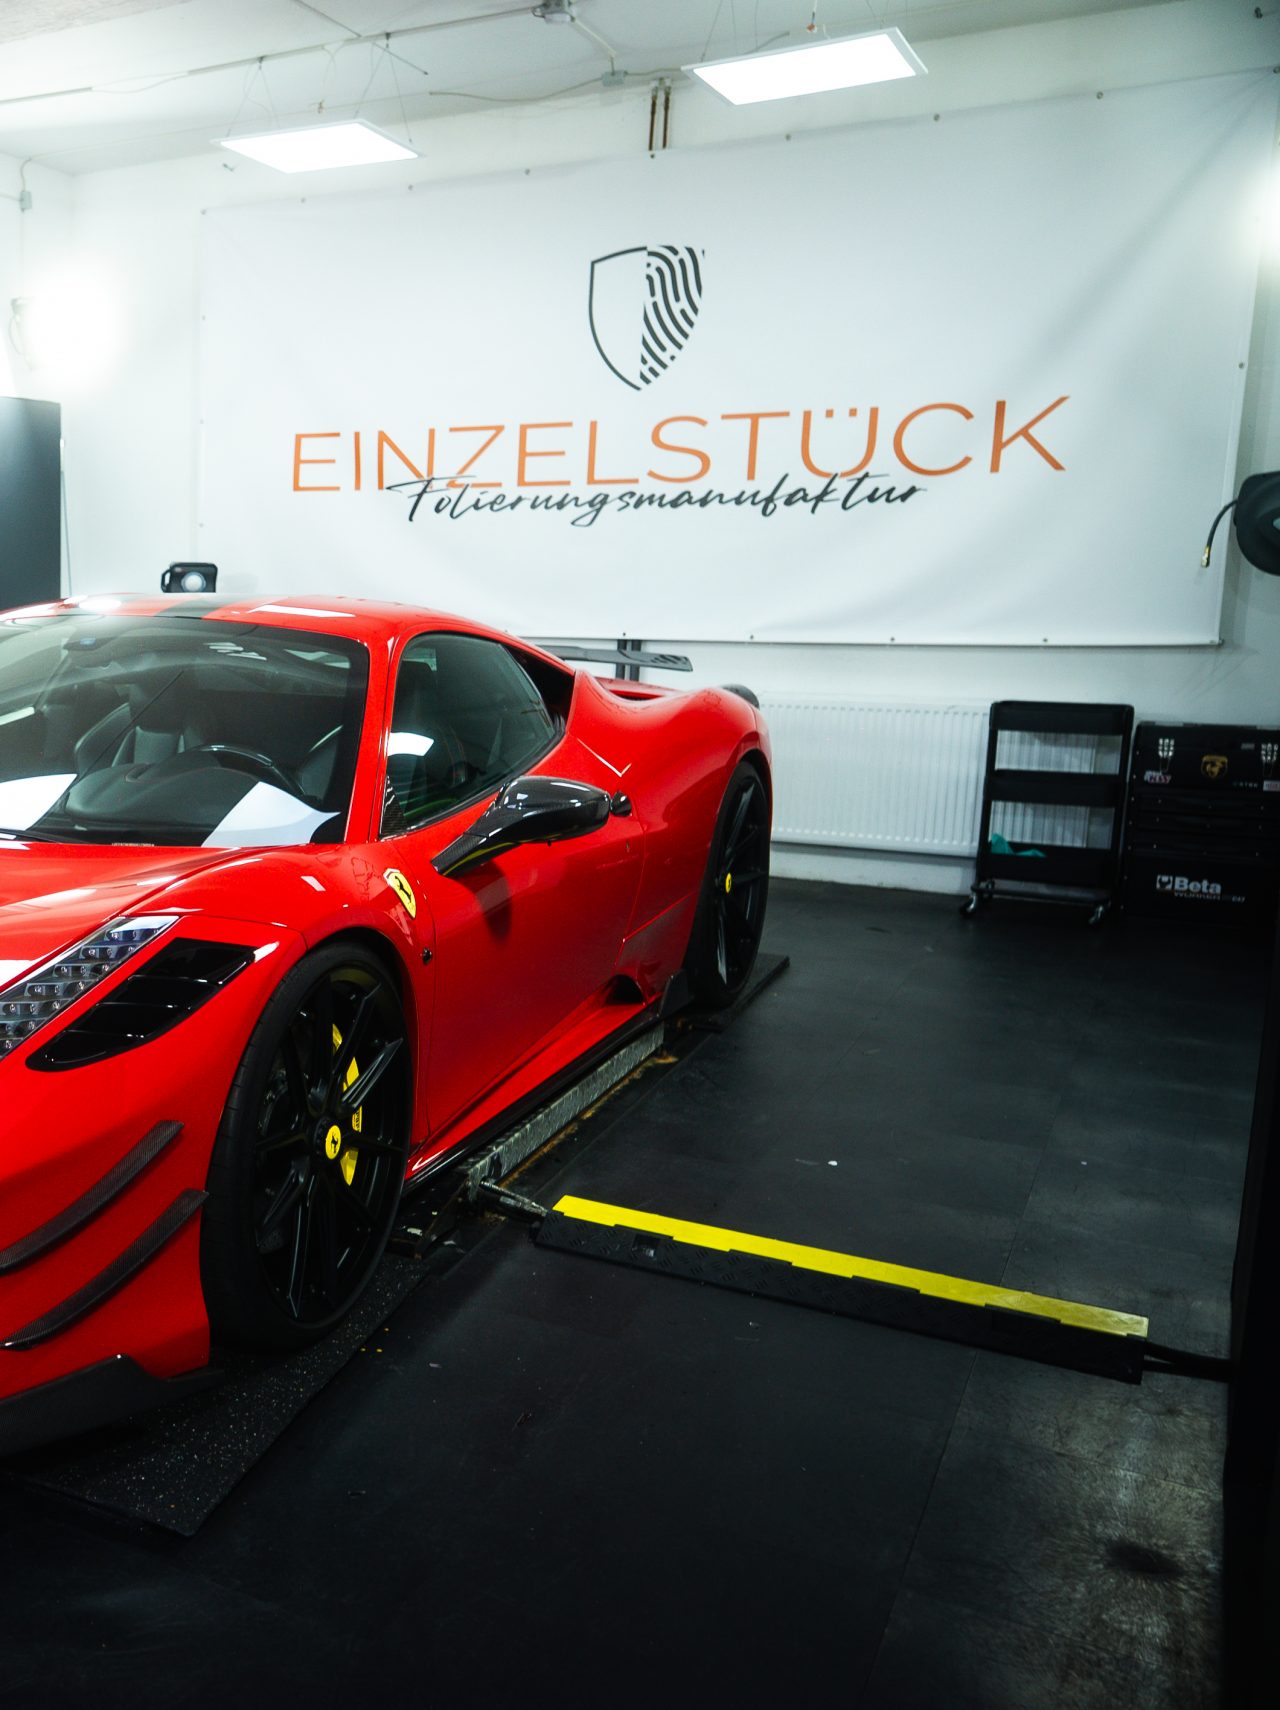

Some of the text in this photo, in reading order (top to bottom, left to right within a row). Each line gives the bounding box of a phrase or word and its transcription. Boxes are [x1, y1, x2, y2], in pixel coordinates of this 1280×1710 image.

[292, 395, 1070, 493] EINZELSTÜCK
[385, 471, 927, 528] Folierungsmanufaktur
[1174, 876, 1222, 894] Beta
